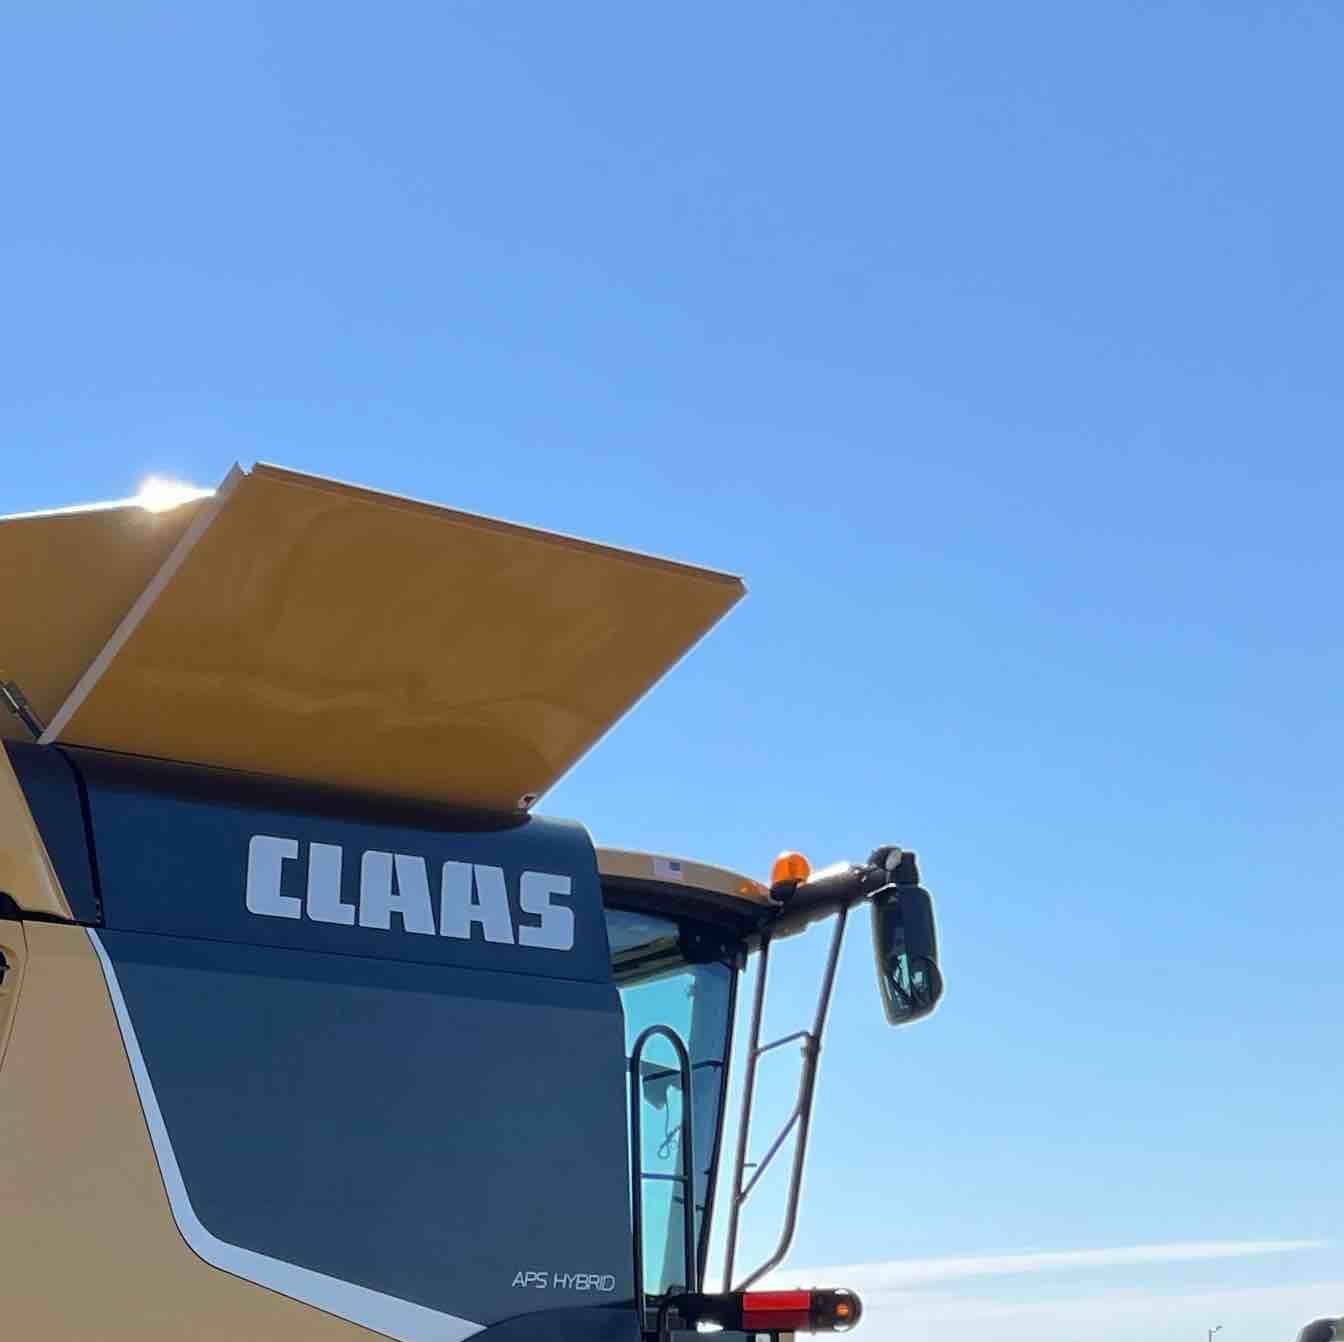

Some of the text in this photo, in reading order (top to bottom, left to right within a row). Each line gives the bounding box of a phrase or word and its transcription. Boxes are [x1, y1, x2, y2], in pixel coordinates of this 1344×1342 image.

[246, 834, 575, 951] CLAAS
[512, 1271, 616, 1292] APS HYBRID
